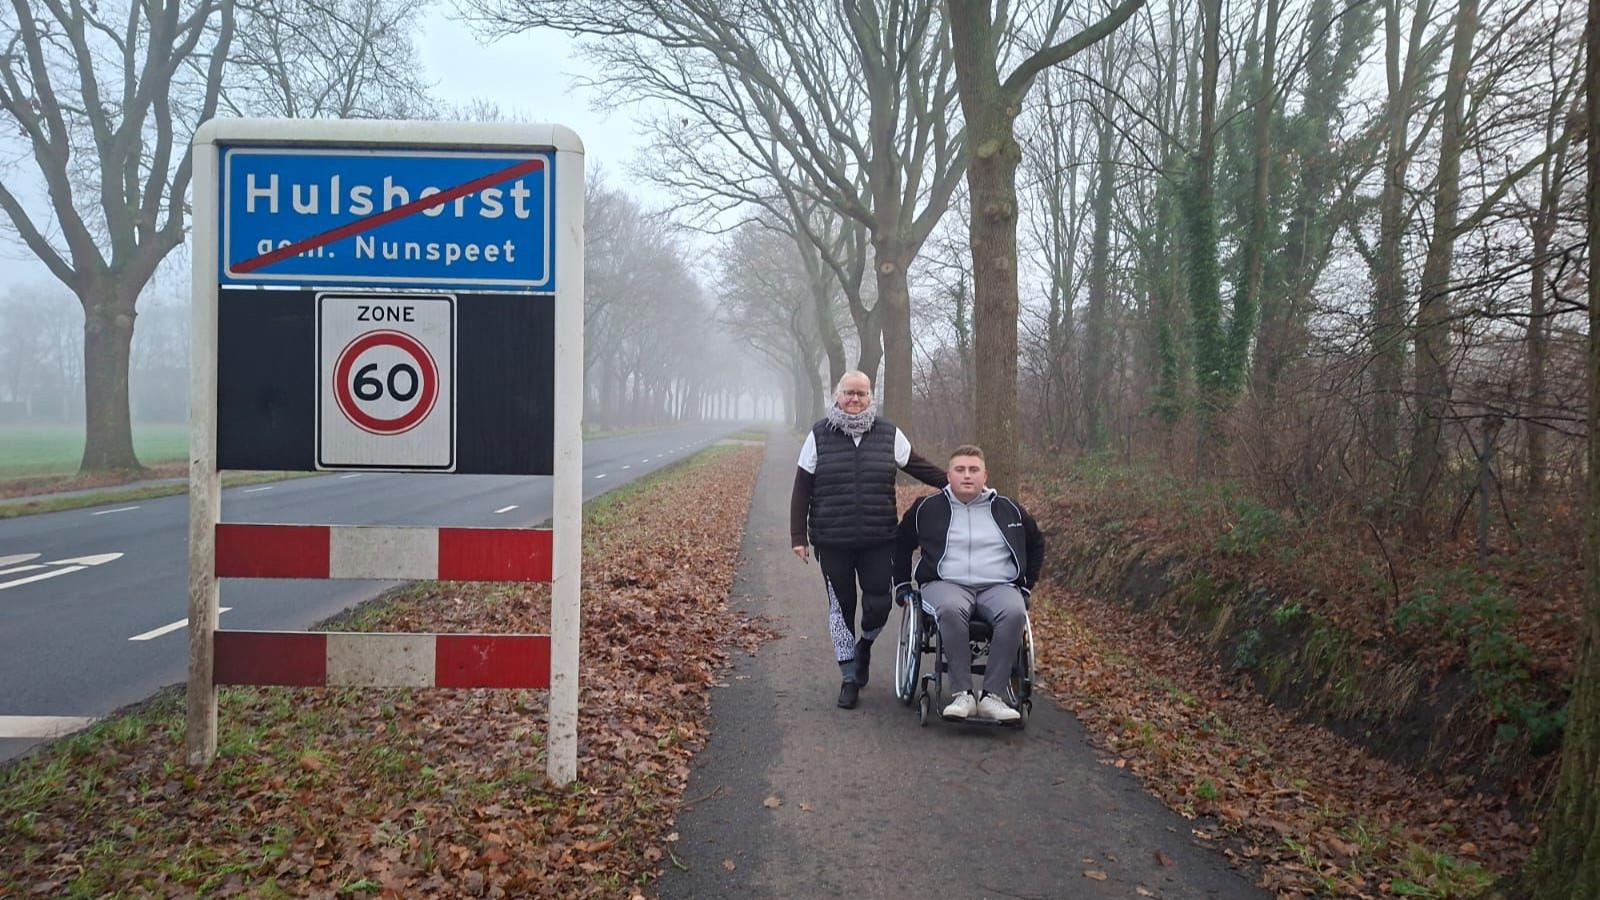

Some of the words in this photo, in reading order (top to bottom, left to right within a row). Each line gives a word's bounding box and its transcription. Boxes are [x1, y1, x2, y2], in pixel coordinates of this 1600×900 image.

[246, 173, 531, 219] Hulshorst
[355, 235, 515, 266] Nunspeet
[357, 306, 415, 322] ZONE
[353, 363, 419, 401] 60
